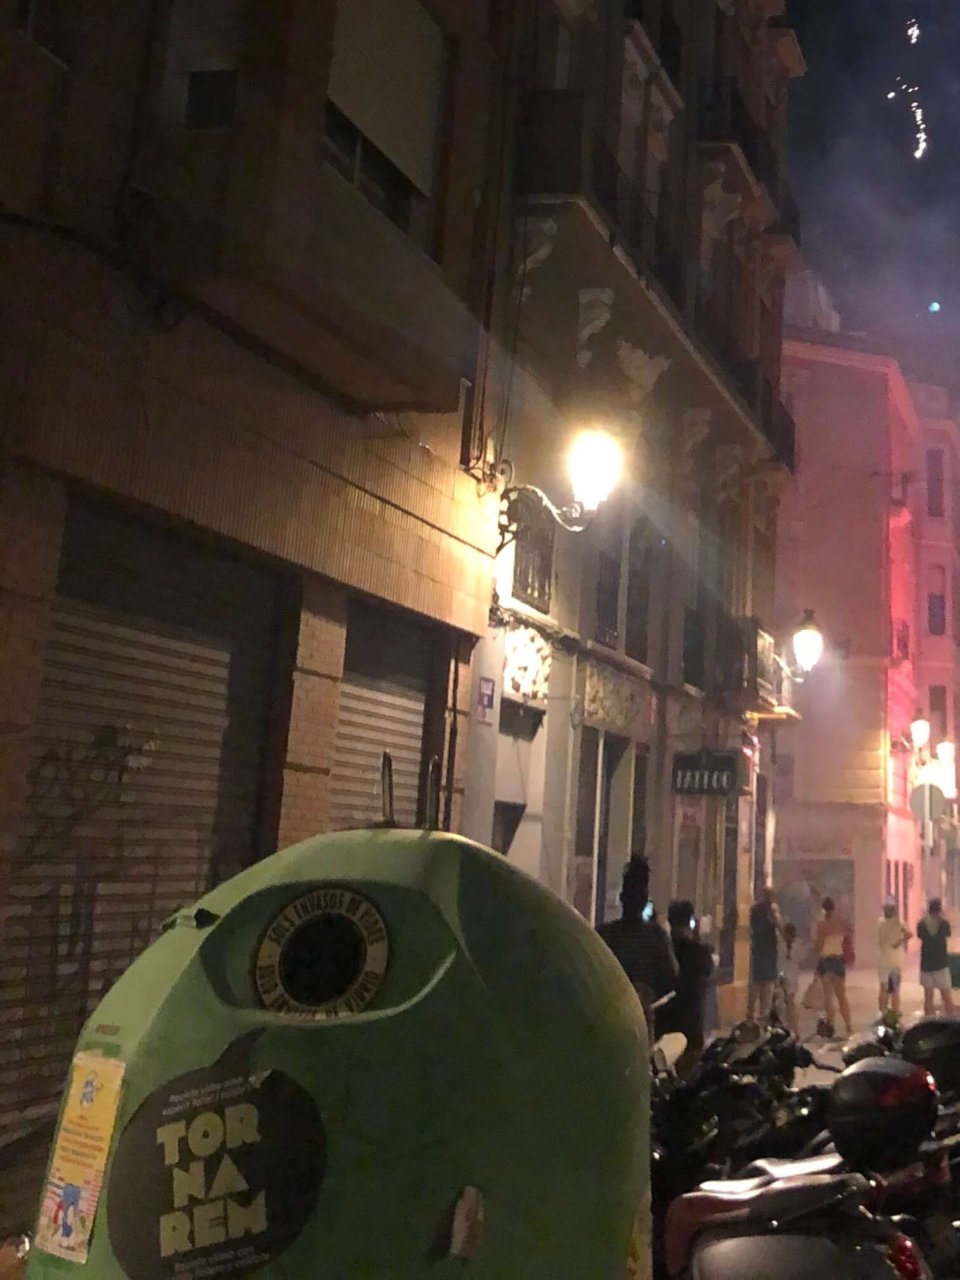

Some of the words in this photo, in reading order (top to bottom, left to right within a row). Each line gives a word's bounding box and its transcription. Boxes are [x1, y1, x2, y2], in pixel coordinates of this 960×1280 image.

[292, 892, 345, 919] ENVASOS
[346, 896, 363, 915] DE
[360, 906, 386, 946] VIDRE
[156, 1102, 263, 1166] TOR
[172, 1153, 250, 1208] NA
[159, 1189, 269, 1258] REM
